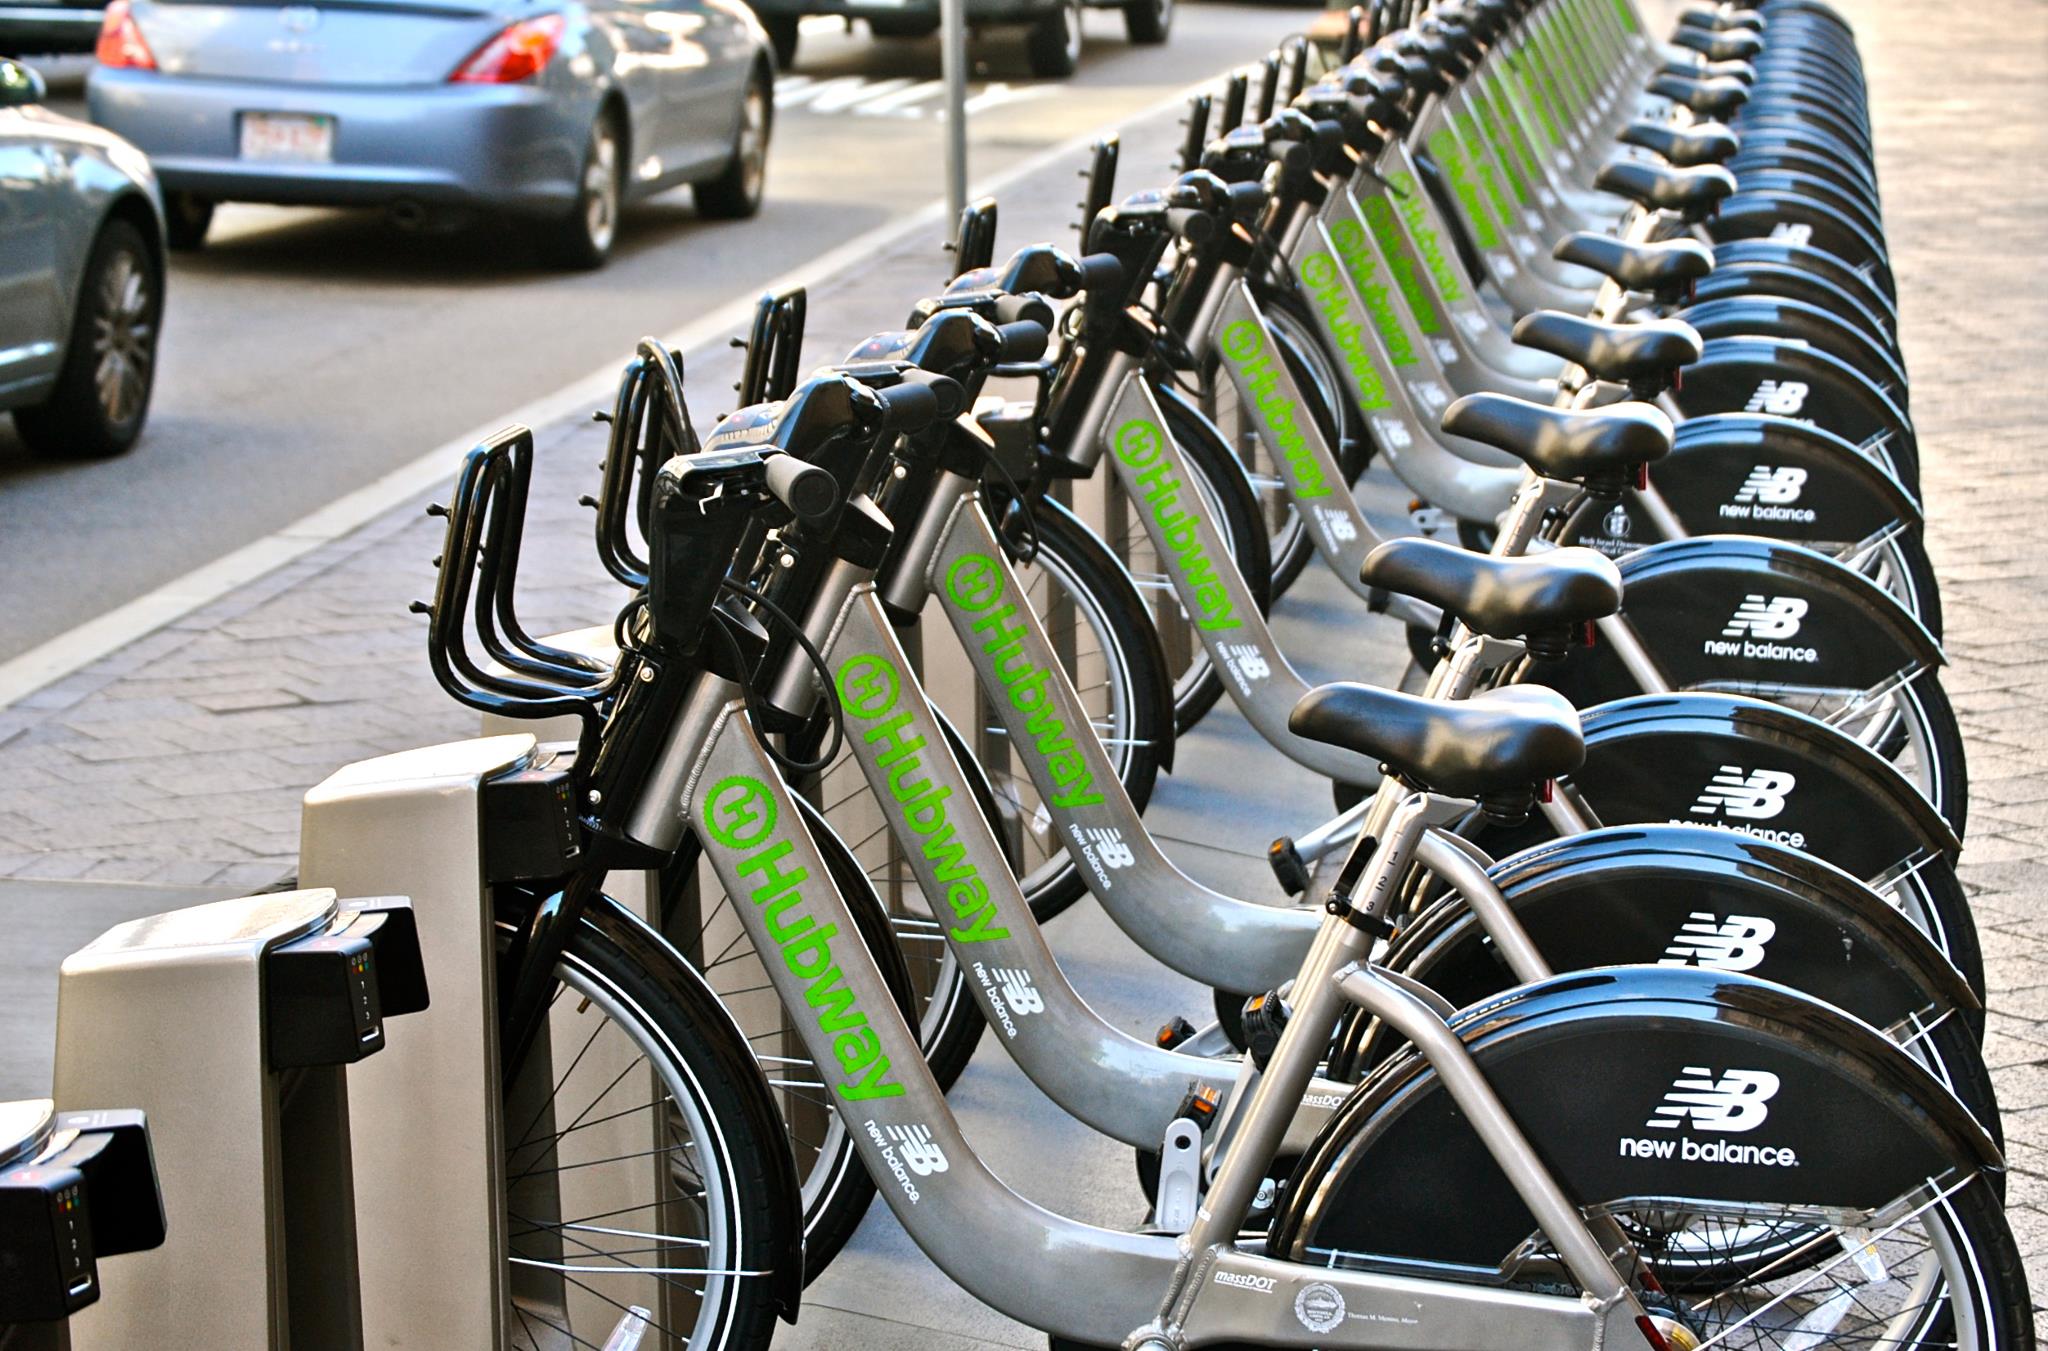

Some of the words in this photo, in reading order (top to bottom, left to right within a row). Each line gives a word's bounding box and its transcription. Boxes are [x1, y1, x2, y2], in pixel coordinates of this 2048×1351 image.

[1316, 283, 1393, 411] Hubway
[1744, 380, 1808, 415] NB
[1240, 354, 1333, 499] Hubway
[1734, 465, 1808, 503] NB
[1719, 504, 1751, 518] new
[1135, 460, 1243, 632] Hubway
[1722, 594, 1808, 639] NB
[1704, 640, 1741, 656] new
[1743, 640, 1817, 663] balance
[970, 602, 1105, 810] Hubway
[1689, 765, 1796, 819] NB
[863, 710, 1011, 945] Hubway
[1069, 823, 1088, 846] new
[1086, 827, 1135, 869] NB
[1392, 851, 1398, 861] 1
[1378, 876, 1387, 887] 2
[1366, 901, 1375, 912] 3
[1656, 911, 1776, 971] NB
[735, 839, 906, 1102] Hubway
[972, 961, 993, 987] new
[991, 967, 1045, 1016] NB
[1645, 1066, 1780, 1132] NB
[864, 1119, 888, 1147] new
[885, 1123, 950, 1176] NB
[1620, 1137, 1677, 1159] new
[1681, 1136, 1796, 1167] balance
[1215, 1270, 1277, 1292] massDOT
